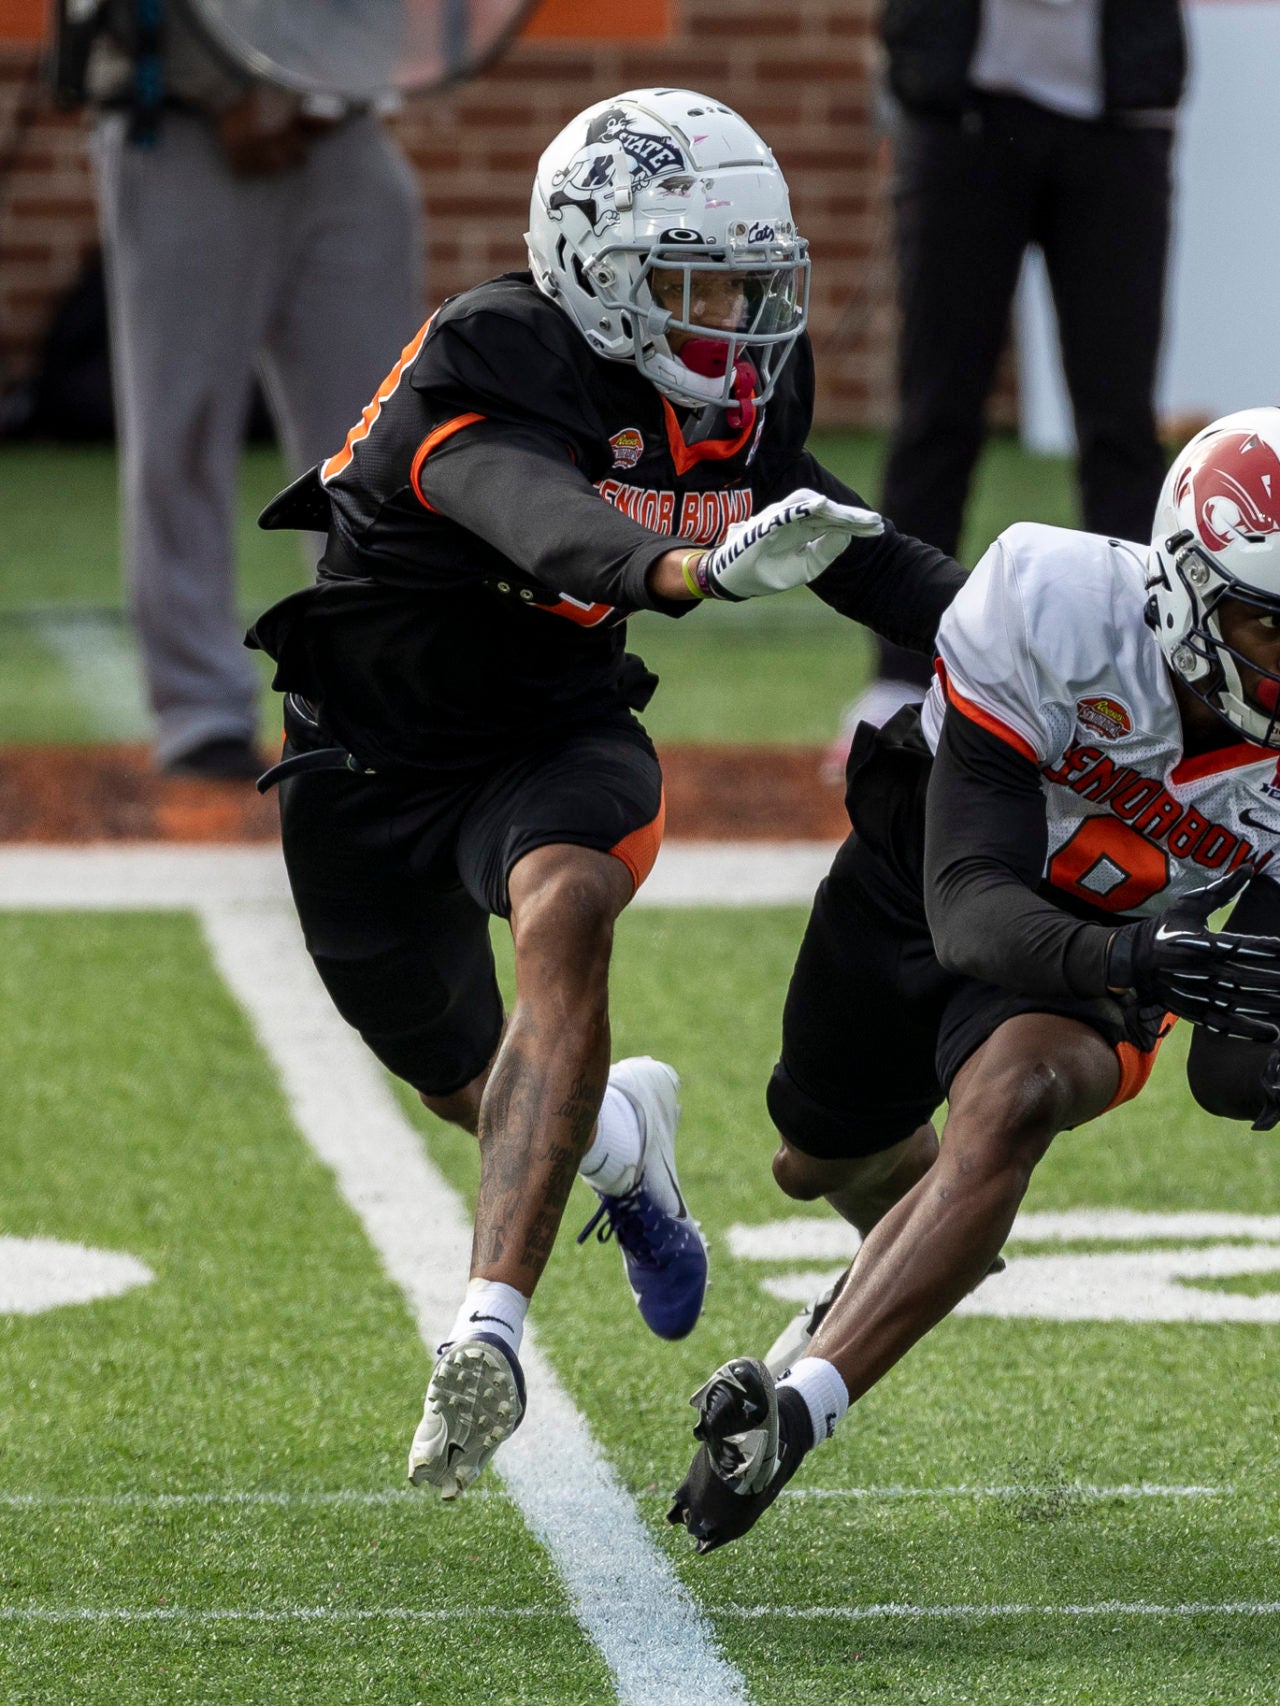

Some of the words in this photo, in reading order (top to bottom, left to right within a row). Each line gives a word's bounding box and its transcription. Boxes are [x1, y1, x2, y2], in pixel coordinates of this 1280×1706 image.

[618, 130, 676, 169] STATE
[747, 221, 775, 244] Cats
[594, 478, 675, 536] ENIOR
[1168, 805, 1275, 876] BOW
